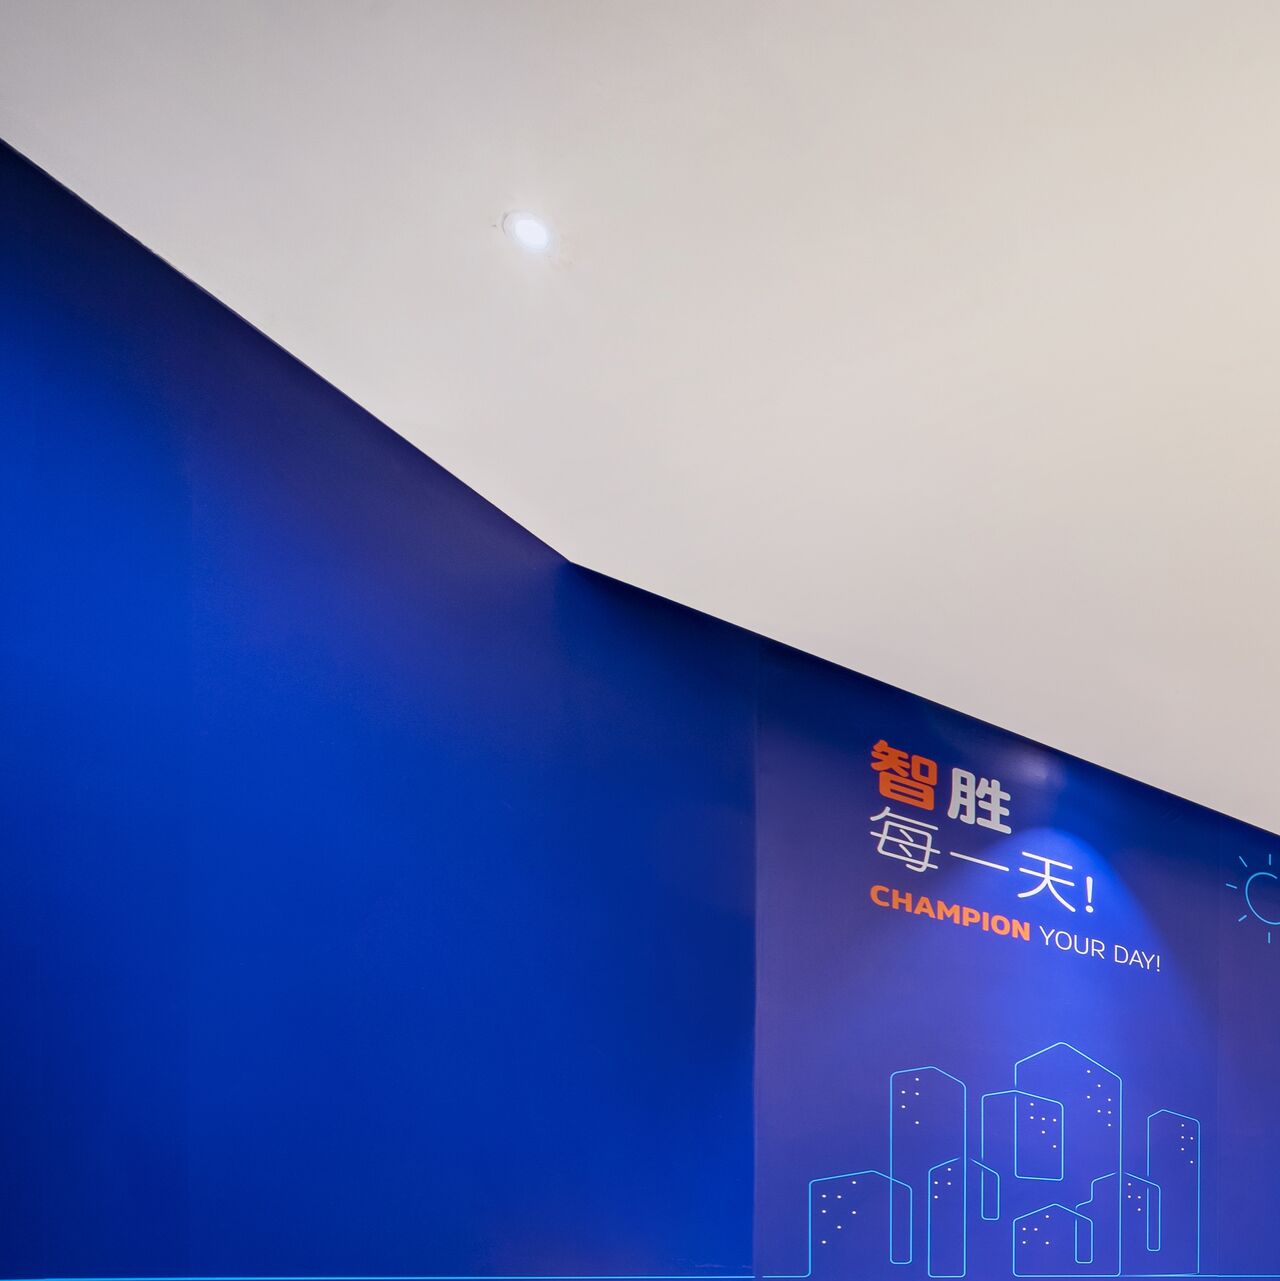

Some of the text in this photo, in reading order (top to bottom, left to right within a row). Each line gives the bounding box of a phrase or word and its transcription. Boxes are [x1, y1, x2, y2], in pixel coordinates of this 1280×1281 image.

[870, 739, 1012, 835] 智胜
[869, 806, 1094, 914] 每一天!
[869, 884, 1161, 972] CHAMPION YOUR DAY!
